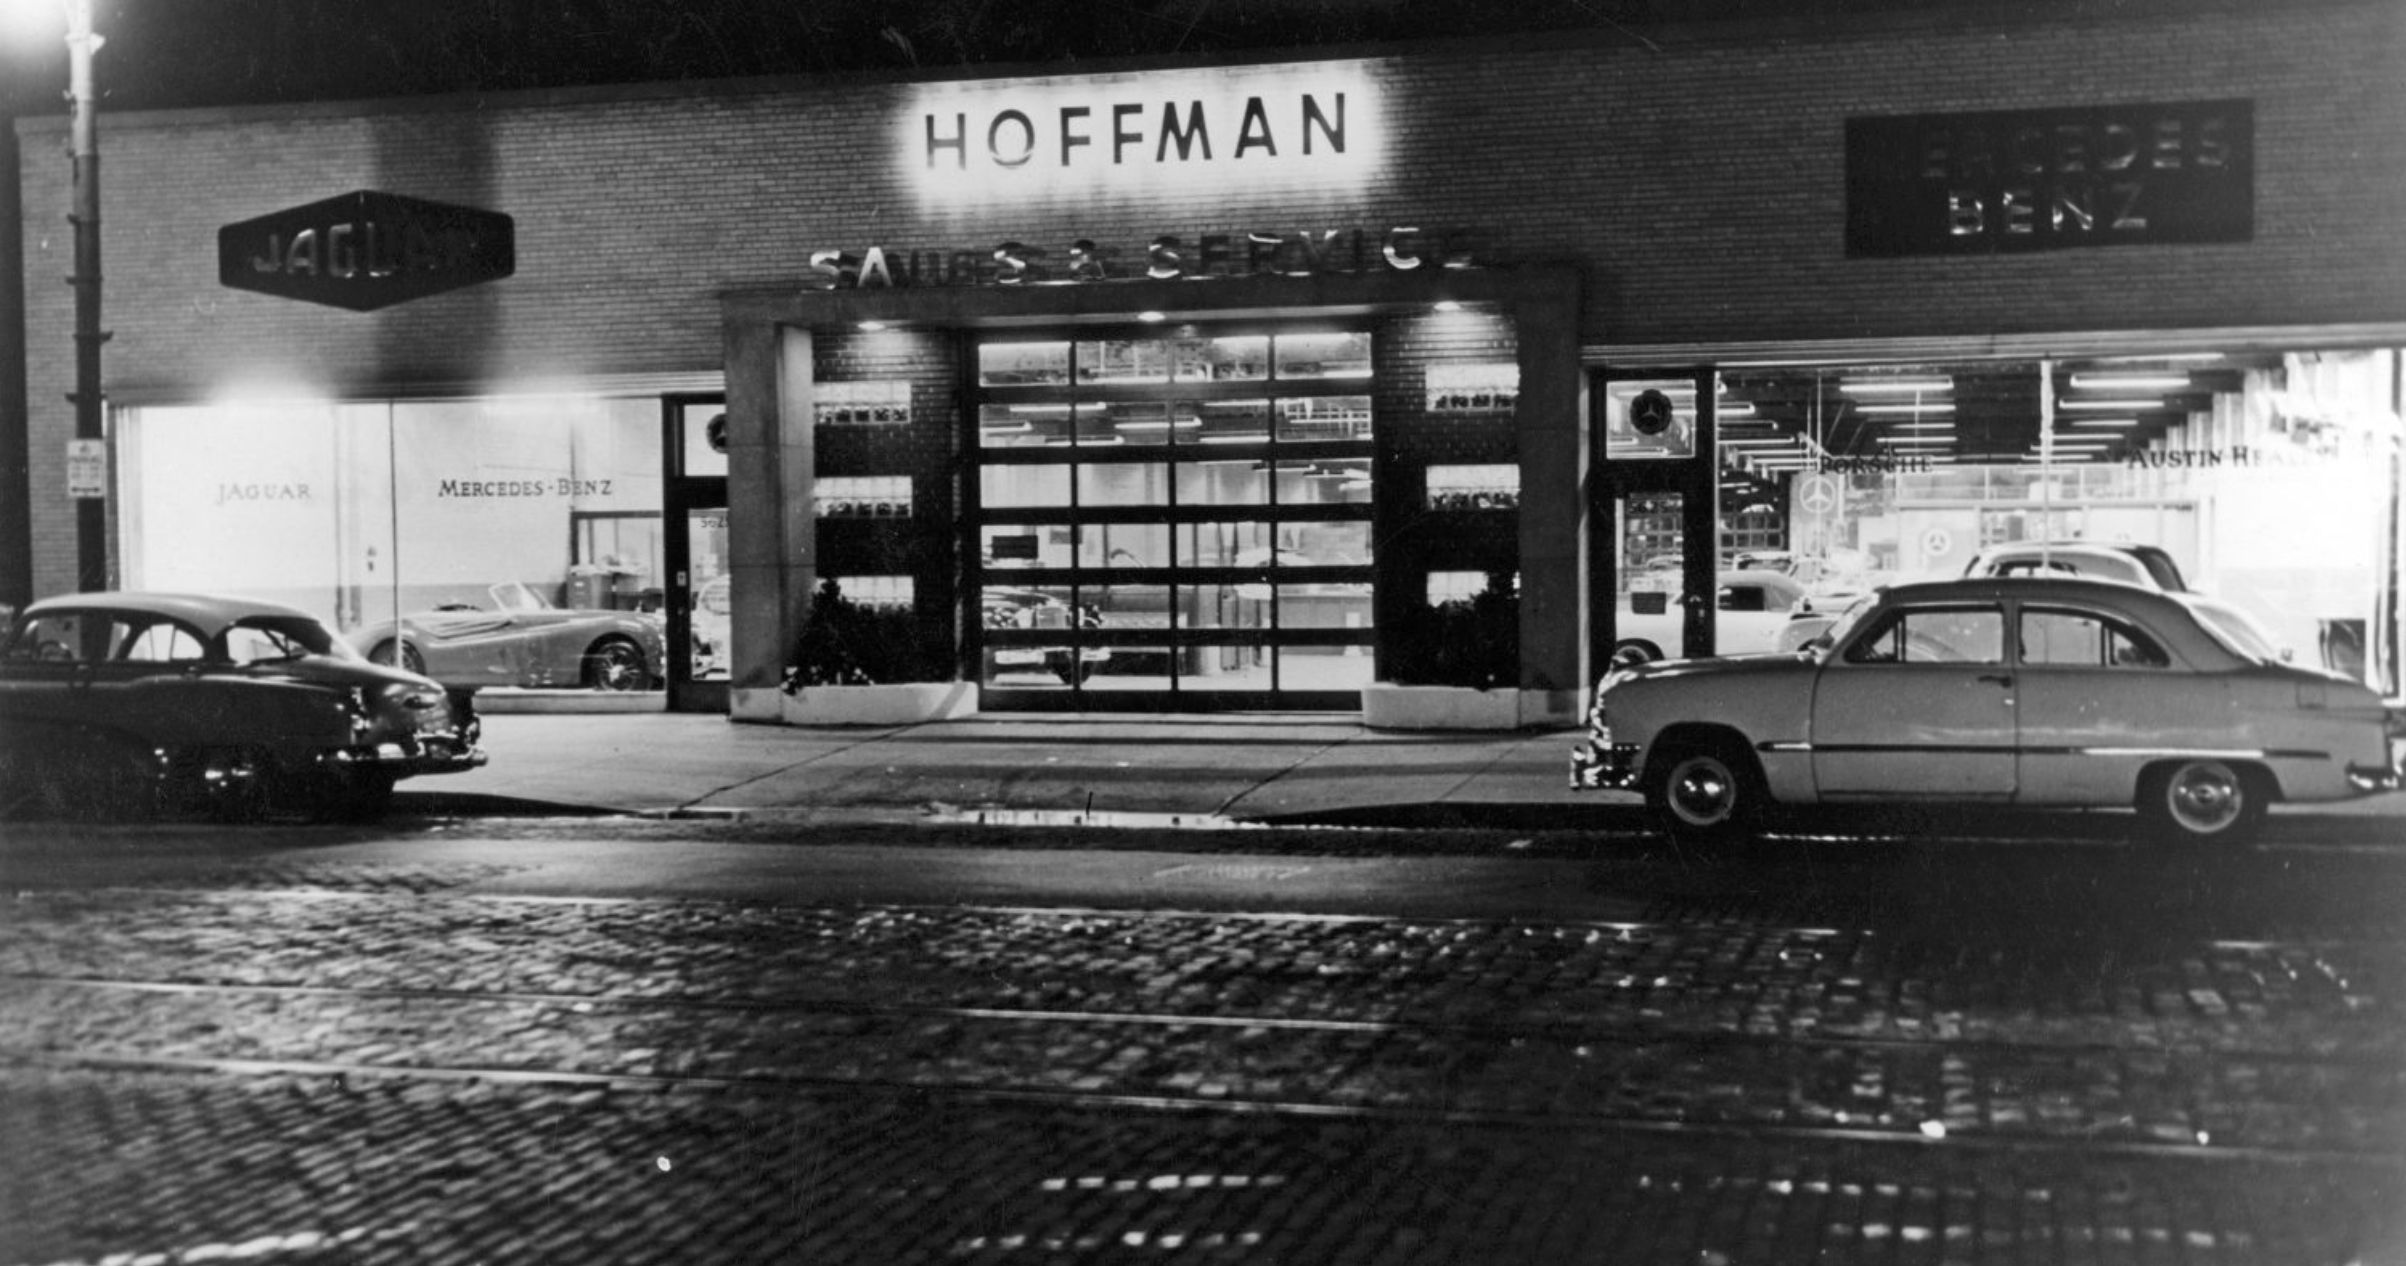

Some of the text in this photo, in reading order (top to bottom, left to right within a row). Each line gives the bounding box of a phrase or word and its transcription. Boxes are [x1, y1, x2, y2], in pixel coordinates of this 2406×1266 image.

[925, 92, 1346, 170] HOFFMAN
[1880, 118, 2231, 179] ERCEDES
[1948, 182, 2149, 236] BENZ
[249, 221, 470, 280] JAGUA
[1818, 456, 1934, 475] PORSCHE
[2128, 449, 2222, 469] AUSTIN
[215, 483, 312, 507] JAGUAR
